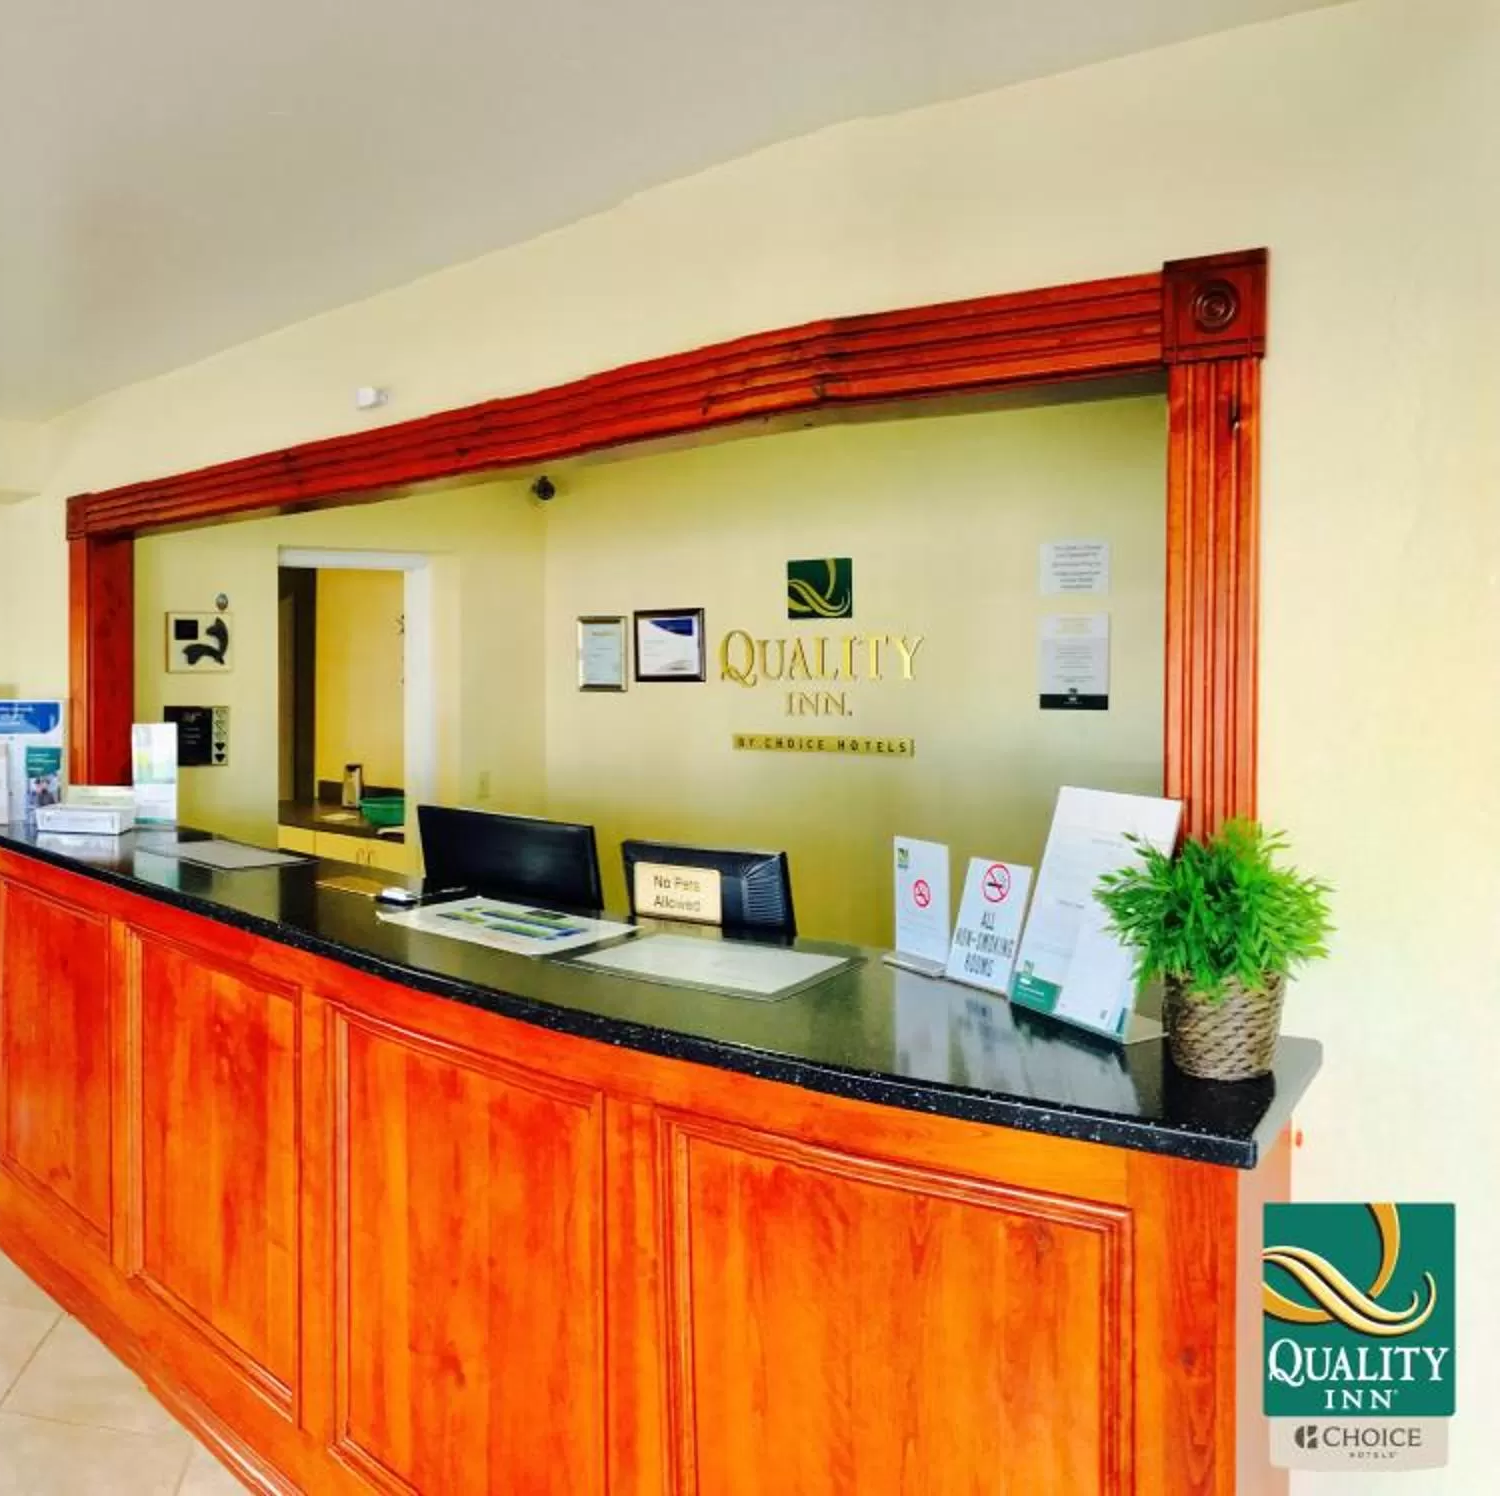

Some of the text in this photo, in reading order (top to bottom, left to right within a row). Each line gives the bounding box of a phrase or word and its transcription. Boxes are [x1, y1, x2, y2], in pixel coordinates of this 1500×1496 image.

[719, 629, 924, 687] QUALITY
[738, 735, 907, 754] BY CHOICE HOTELS
[653, 875, 701, 893] No Pets
[653, 895, 701, 912] Allowed
[980, 911, 996, 931] ALL
[964, 951, 995, 978] ROOMS
